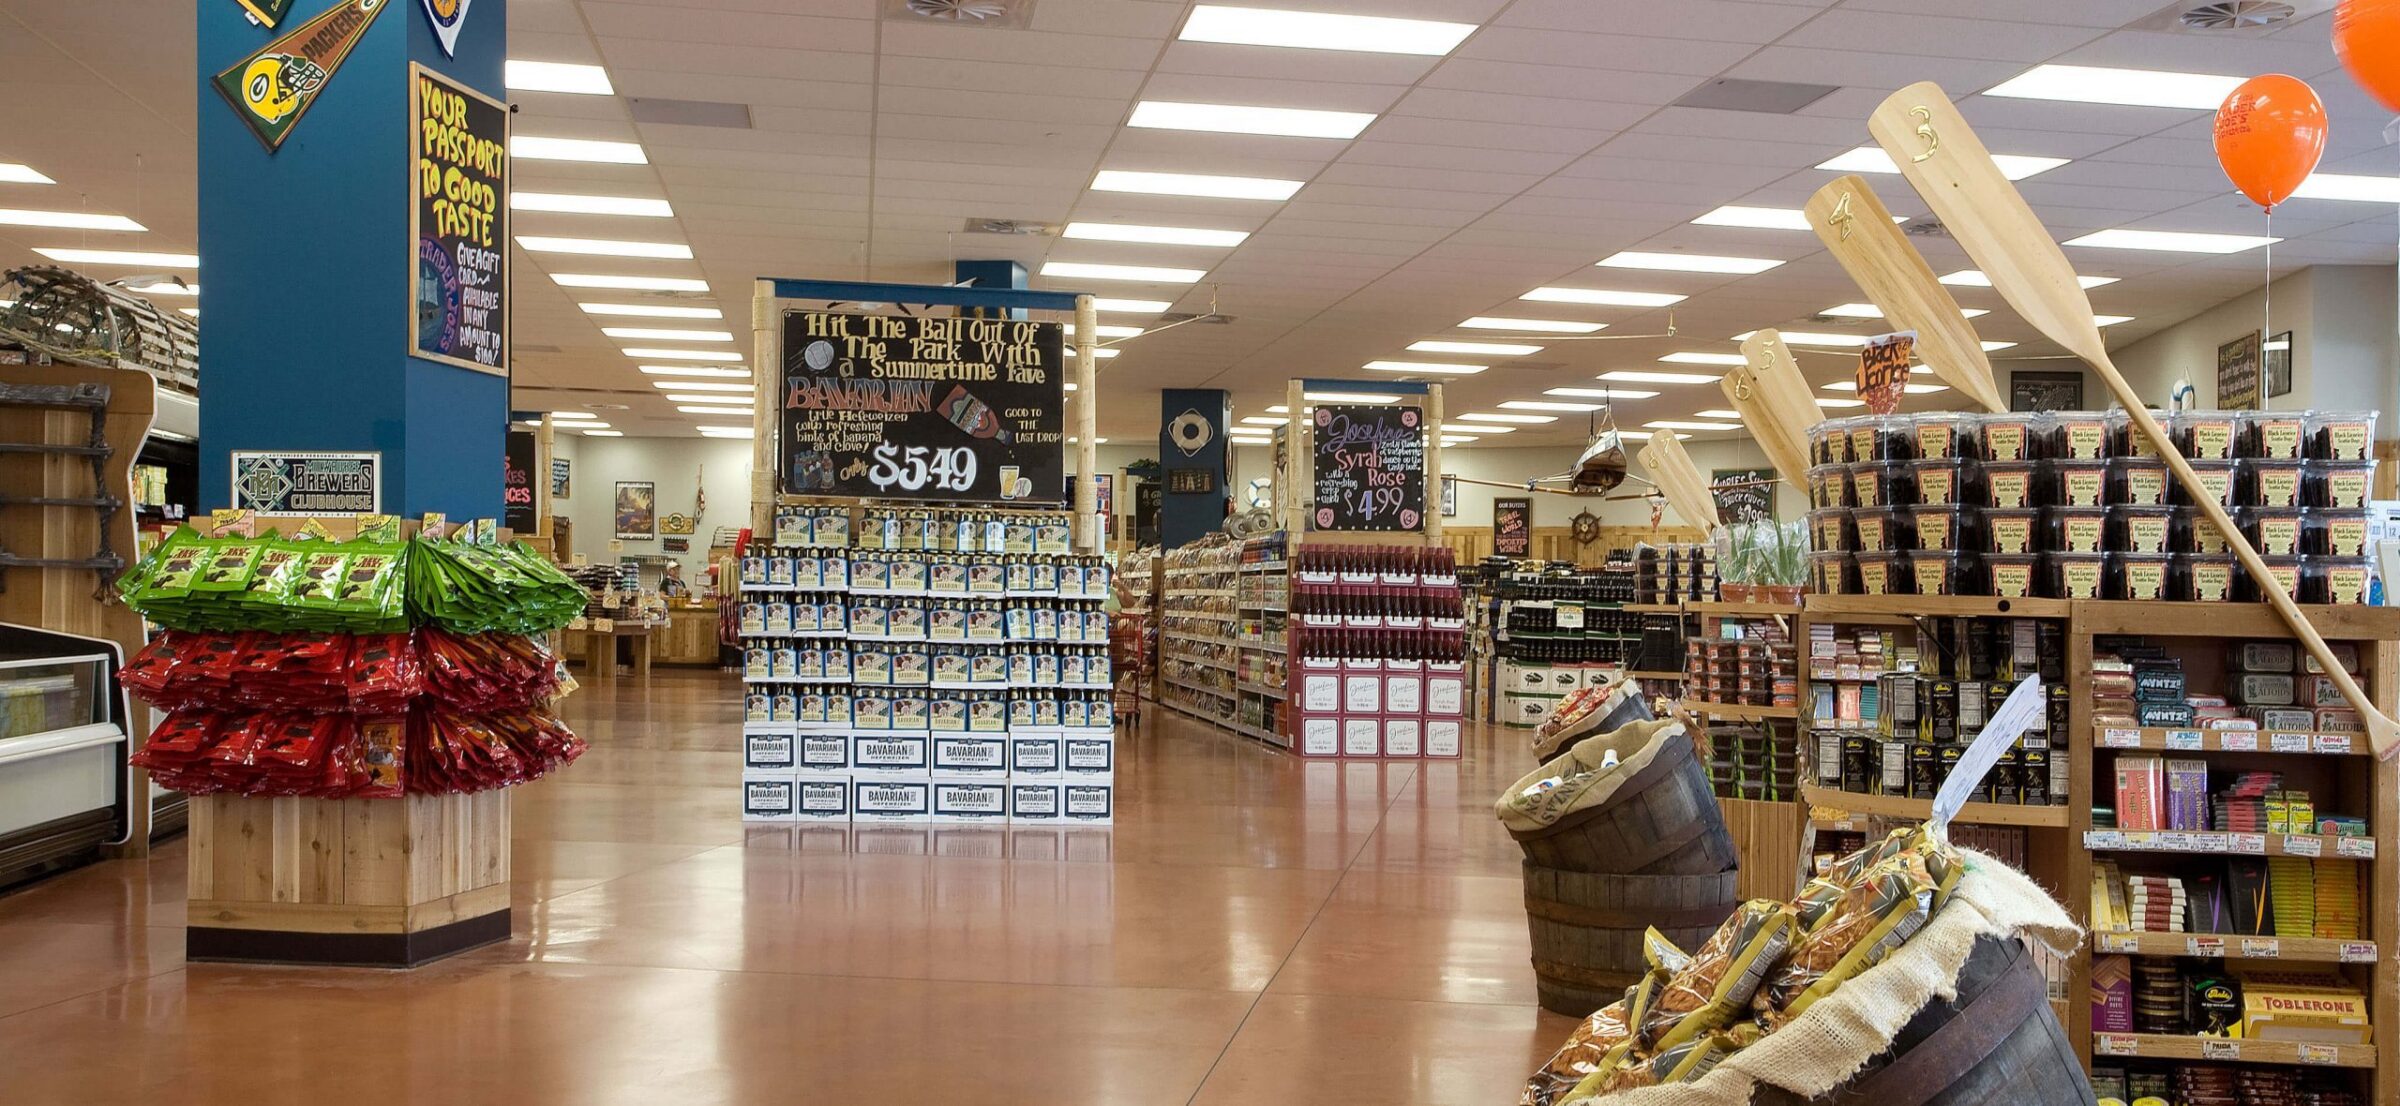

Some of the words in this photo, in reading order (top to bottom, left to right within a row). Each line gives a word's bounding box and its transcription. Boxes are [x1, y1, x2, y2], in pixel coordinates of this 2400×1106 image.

[300, 5, 365, 63] PACKERS
[419, 77, 469, 130] YOUR
[1909, 105, 1939, 163] 3
[422, 117, 504, 180] PASSPORT
[420, 157, 441, 198] TO
[444, 165, 495, 214] GOOD
[432, 198, 494, 248] TASTE
[1829, 191, 1853, 241] 4
[457, 241, 476, 268] GIVE
[482, 250, 500, 275] GIFT
[458, 266, 478, 286] CARD
[420, 240, 457, 297] TRADER
[441, 298, 459, 351] JOE'S
[462, 286, 499, 310] AVAILABLE
[463, 305, 473, 324] IN
[473, 308, 489, 330] ANY
[460, 325, 491, 349] AMOUNT
[491, 331, 501, 350] TO
[804, 313, 850, 337] Hit
[863, 315, 907, 339] The
[917, 318, 963, 342] Ball
[969, 320, 1005, 344] Out
[1013, 322, 1040, 345] Of
[475, 346, 498, 366] $100!
[843, 335, 887, 360] The
[909, 336, 962, 361] Park
[981, 341, 1042, 366] With
[1758, 340, 1777, 371] 5
[1862, 342, 1900, 371] Black
[839, 357, 855, 378] a
[871, 357, 998, 381] Summertime
[1006, 362, 1046, 384] Fave
[1856, 361, 1910, 397] Licorice
[786, 376, 936, 413] BAVARIAN
[1735, 373, 1751, 401] 6
[808, 410, 835, 422] true
[839, 410, 909, 422] Hefeweizen
[1005, 407, 1029, 418] GOOD
[1031, 408, 1042, 417] TO
[796, 420, 823, 432] with
[826, 420, 884, 433] refreshing
[1018, 419, 1038, 430] THE
[797, 431, 824, 443] hints
[828, 431, 840, 443] of
[843, 432, 882, 443] banana
[1015, 432, 1035, 444] LAST
[1037, 433, 1062, 443] DROP!
[813, 442, 832, 452] and
[834, 441, 870, 454] clove!
[1334, 443, 1382, 471] Syrah
[305, 460, 361, 473] MILWAUKEE
[868, 439, 978, 493] $5.49
[293, 464, 373, 492] BREWERS
[290, 494, 373, 510] CLUBHOUSE
[2257, 688, 2291, 698] ALTOIDS
[2278, 722, 2312, 732] ALTOIDS
[751, 742, 783, 751] BAVARIAN
[806, 743, 838, 752] BAVARIAN
[866, 745, 908, 756] BAVARIAN
[946, 746, 988, 758] BAVARIAN
[1018, 747, 1049, 756] BAVARIAN
[1070, 747, 1101, 756] BAVARIAN
[2170, 762, 2205, 772] ORGANIC
[750, 789, 782, 799] BAVARIAN
[805, 790, 836, 799] BAVARIAN
[868, 791, 910, 802] BAVARIAN
[946, 792, 988, 803] BAVARIAN
[1018, 793, 1049, 802] BAVARIAN
[1070, 793, 1101, 802] BAVARIAN
[2263, 996, 2355, 1014] TOBLERONE
